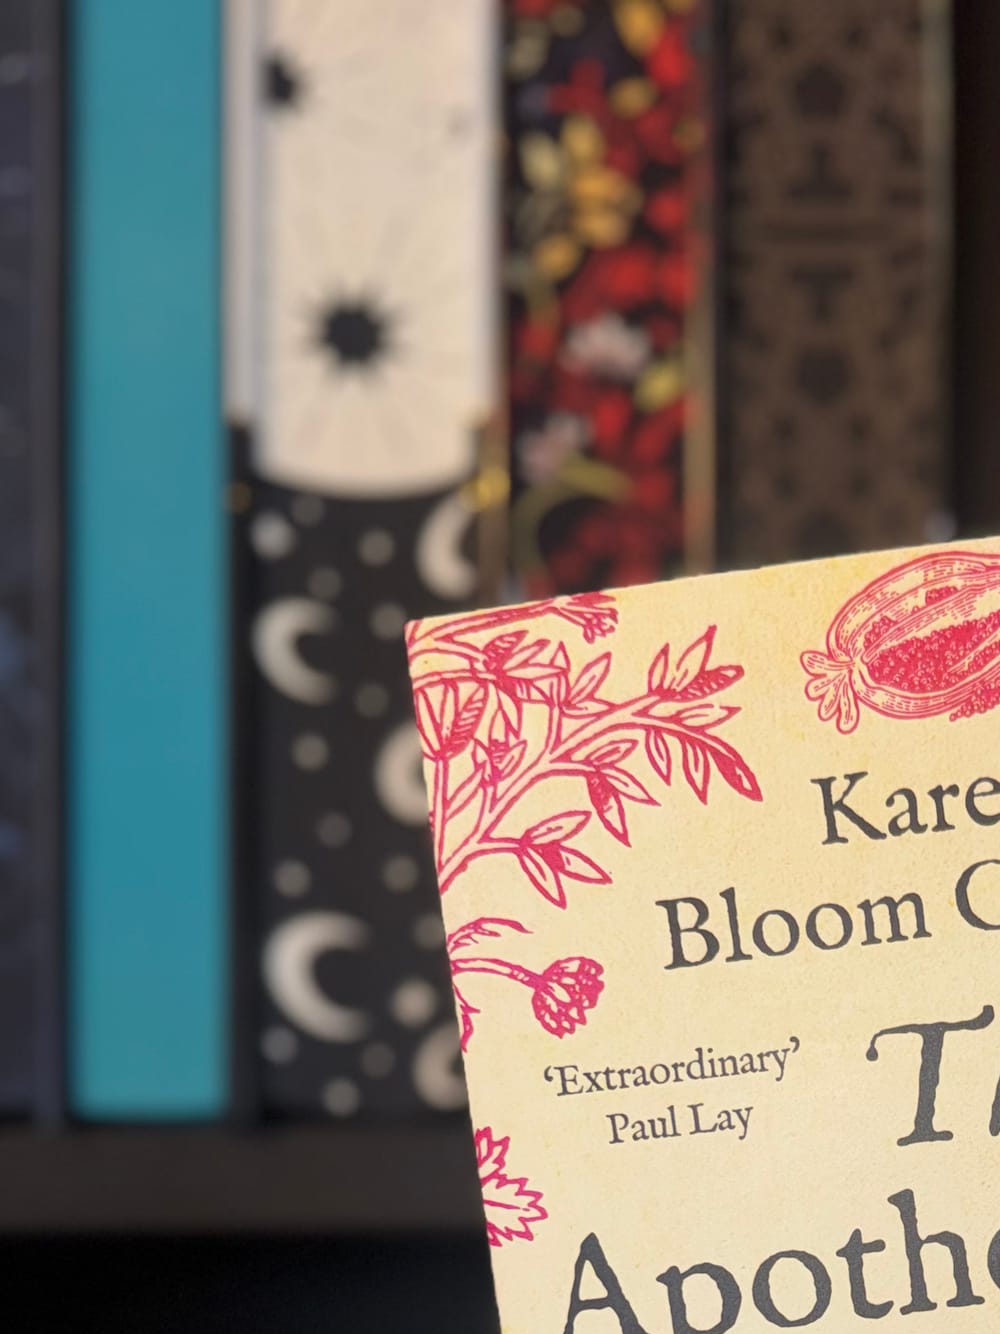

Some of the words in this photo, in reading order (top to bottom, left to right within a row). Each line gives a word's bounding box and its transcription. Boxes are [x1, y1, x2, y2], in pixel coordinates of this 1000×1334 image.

[655, 888, 932, 970] Bloom
[606, 1105, 682, 1144] Paul
[690, 1101, 753, 1138] Lay
